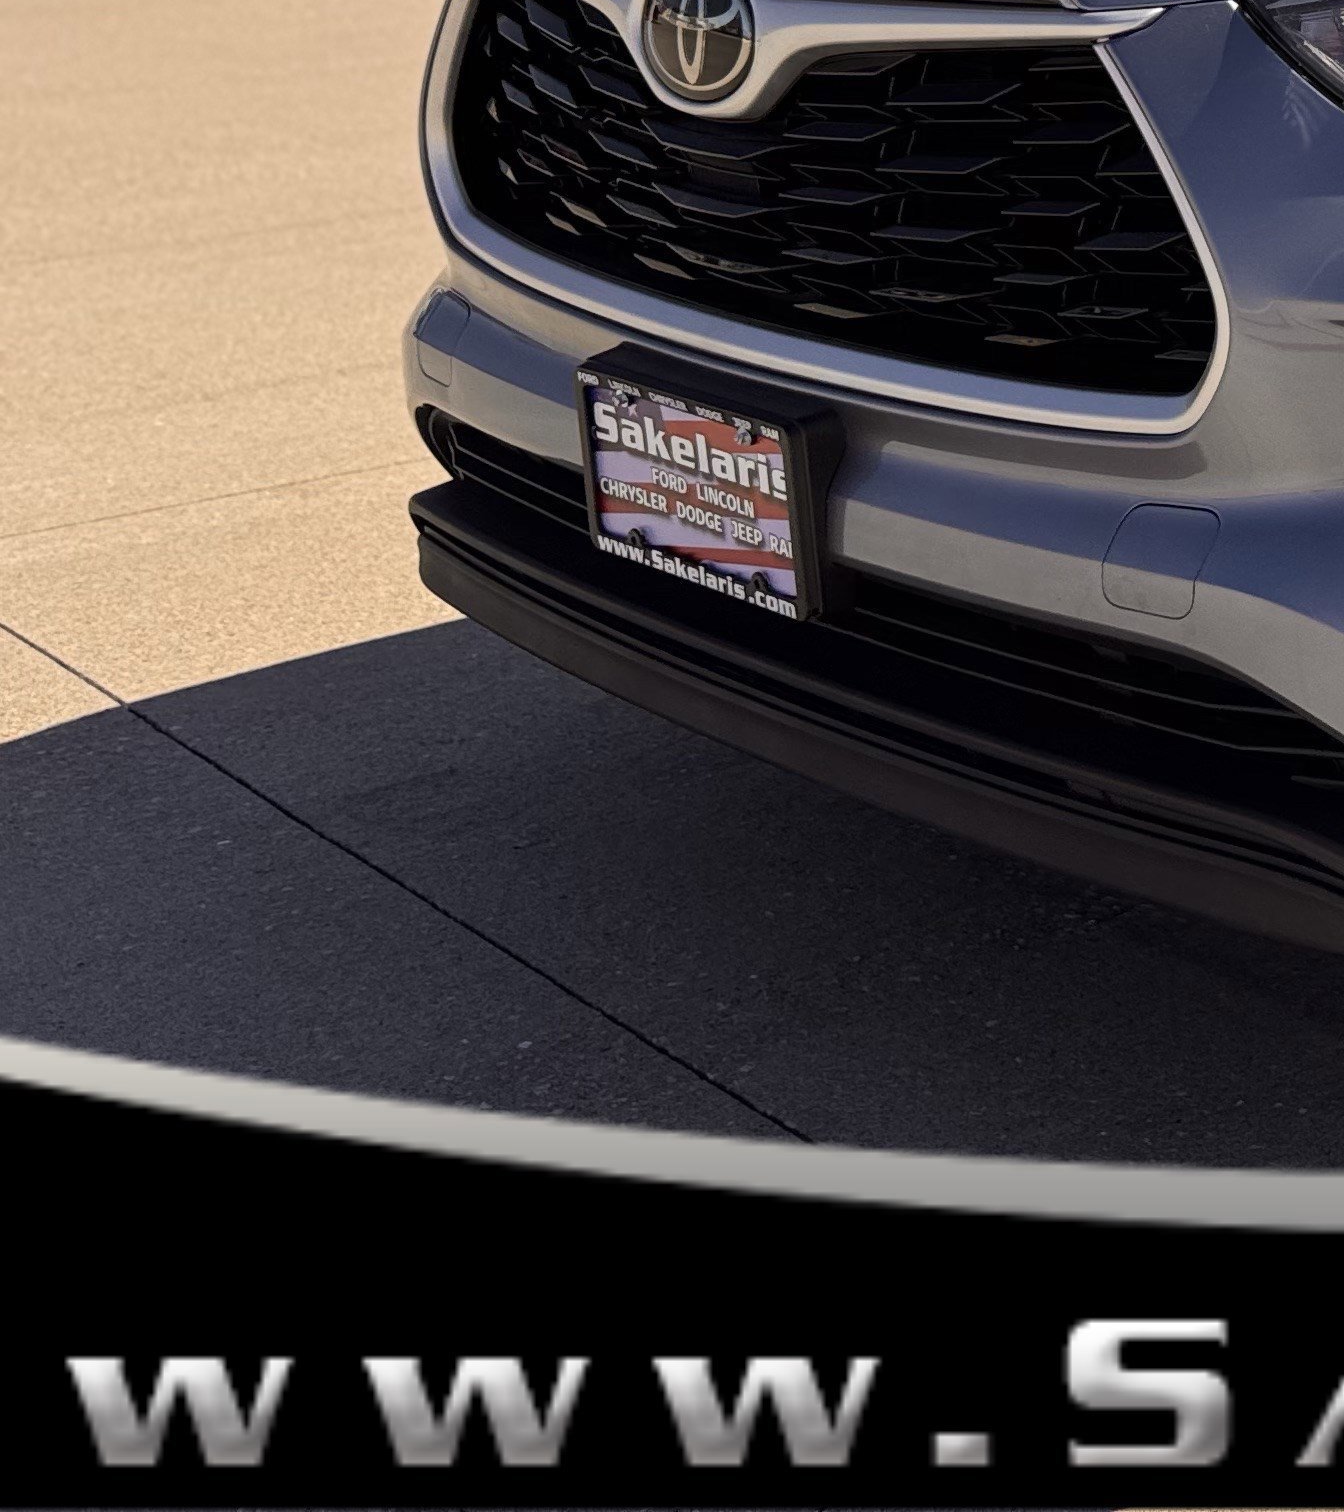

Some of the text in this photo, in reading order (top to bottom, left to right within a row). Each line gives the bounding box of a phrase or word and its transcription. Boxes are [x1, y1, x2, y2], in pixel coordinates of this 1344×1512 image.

[594, 401, 788, 501] Sakelaris
[651, 467, 755, 519] FORD LINCOLN
[600, 477, 793, 560] CHRYSLER DODGE JEEP RA
[597, 534, 798, 620] www.Sakelaris.com
